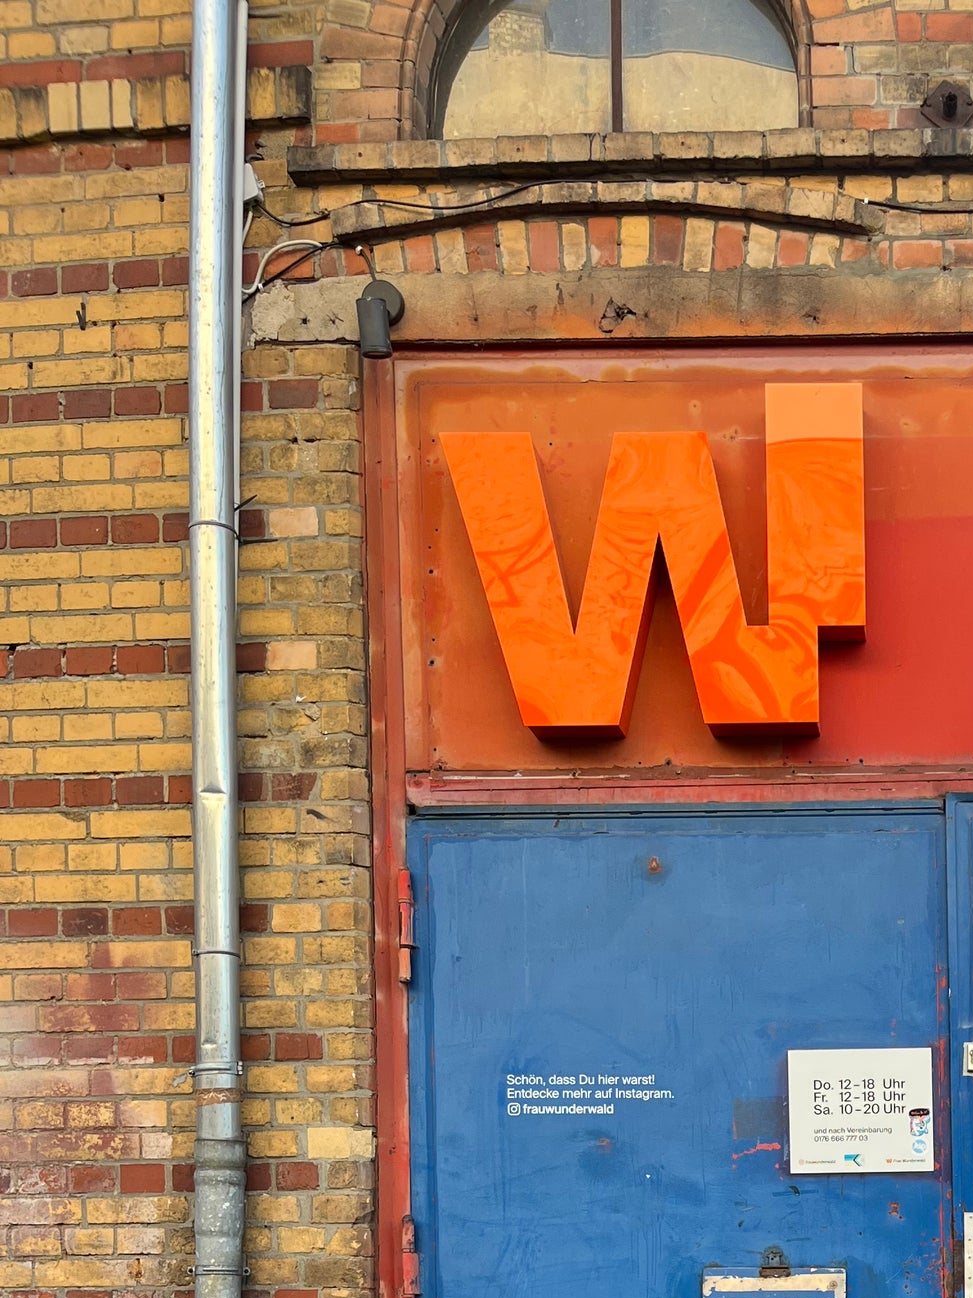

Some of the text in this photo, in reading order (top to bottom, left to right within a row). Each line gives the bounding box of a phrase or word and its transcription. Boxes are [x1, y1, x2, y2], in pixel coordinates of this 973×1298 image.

[506, 1074, 655, 1087] Schön, dass Du hier warst!
[813, 1079, 834, 1091] Do.
[883, 1078, 906, 1090] Uhr
[506, 1087, 675, 1101] Entdecke mehr auf Instagram.
[813, 1091, 829, 1103] Fr.
[883, 1091, 906, 1101] Uhr
[522, 1103, 615, 1115] frauwunderwald
[813, 1104, 834, 1116] Sa.
[883, 1103, 906, 1114] Uhr
[846, 1127, 893, 1135] Vereinbarung
